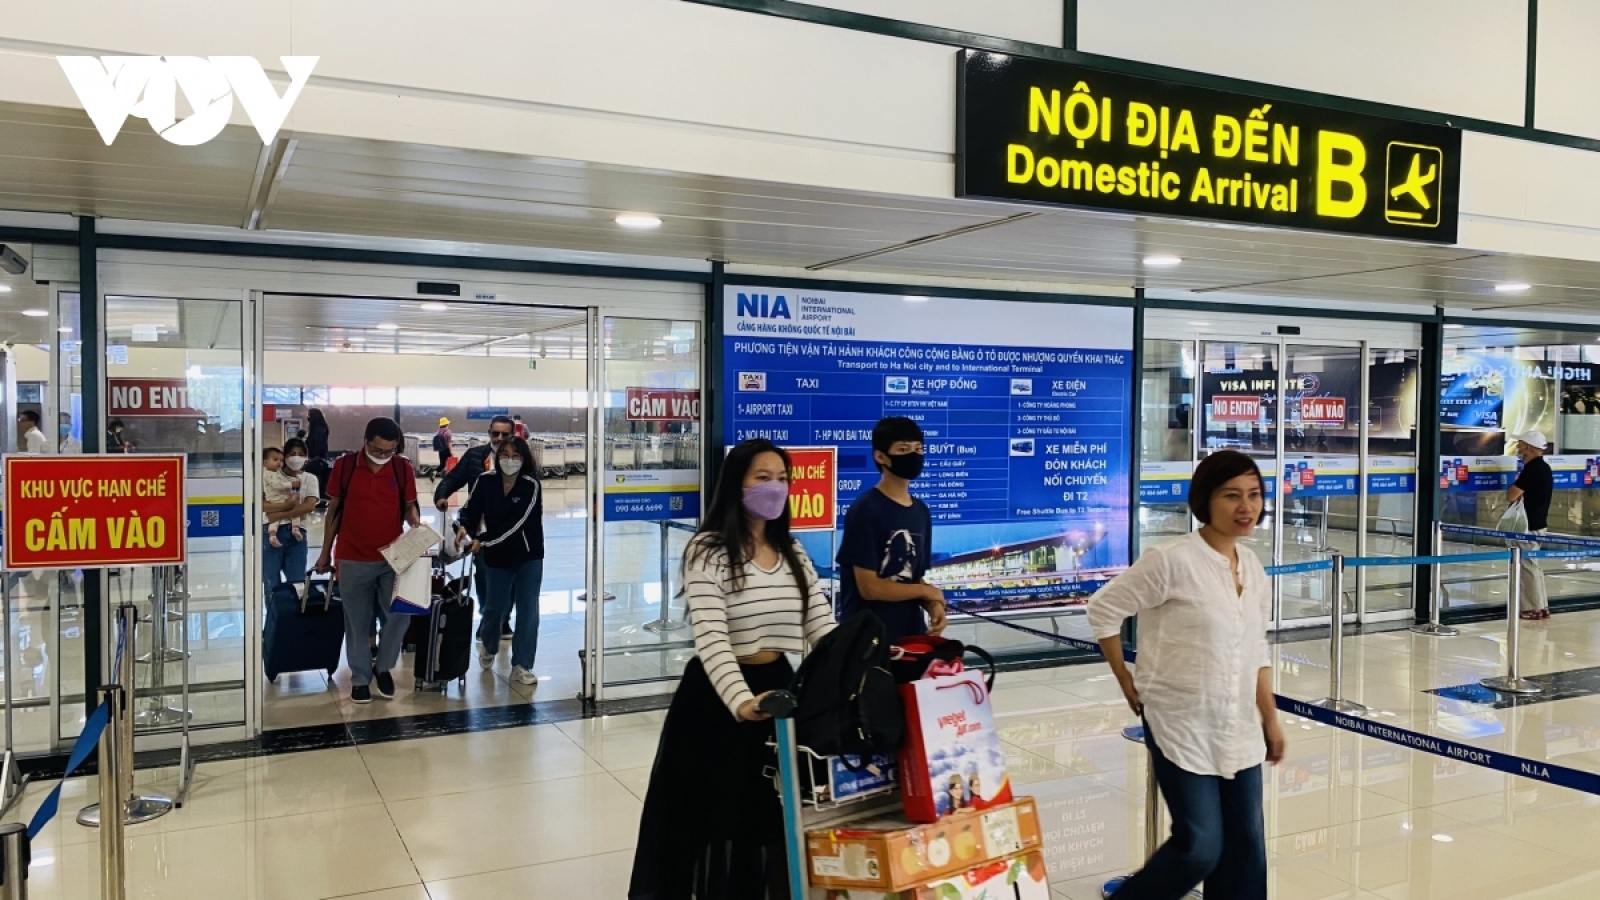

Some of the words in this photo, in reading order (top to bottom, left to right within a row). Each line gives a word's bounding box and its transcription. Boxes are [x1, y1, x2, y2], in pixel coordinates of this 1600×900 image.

[1028, 81, 1111, 148] NỘI
[1127, 102, 1200, 159] ĐỊA
[1213, 104, 1299, 166] ĐẾN
[1007, 143, 1181, 200] Domestic
[1191, 168, 1298, 213] Arrival
[1317, 130, 1367, 219] B
[737, 293, 791, 319] NIA
[801, 297, 826, 305] NOIBAI
[801, 306, 856, 315] INTERNATIONAL
[801, 314, 832, 322] AIRPORT
[737, 320, 756, 332] CẢNG
[757, 322, 777, 333] HÀNG
[778, 323, 801, 334] KHÔNG
[734, 341, 776, 354] PHƯƠNG
[777, 341, 798, 357] TIỆN
[801, 342, 820, 358] VẬN
[822, 342, 837, 356] TẢI
[838, 344, 864, 357] HÀNH
[866, 345, 896, 358] KHÁCH
[898, 346, 923, 359] CÔNG
[925, 347, 950, 362] CỘNG
[951, 346, 975, 360] BẰNG
[998, 350, 1020, 363] ĐƯỢC
[1022, 351, 1056, 364] NHƯỢNG
[1084, 354, 1103, 364] KHAI
[1104, 352, 1124, 365] THÁC
[837, 359, 878, 370] Transport
[880, 361, 889, 369] to
[890, 361, 901, 369] Ha
[903, 361, 917, 370] Noi
[919, 362, 933, 372] city
[935, 363, 950, 371] and
[952, 363, 960, 371] to
[962, 363, 1009, 372] International
[1011, 364, 1043, 373] Terminal
[795, 378, 819, 389] TAXI
[911, 379, 925, 389] XE
[927, 379, 948, 391] HỢP
[949, 376, 978, 390] ĐỒNG
[1051, 380, 1064, 390] XE
[1065, 378, 1086, 392] ĐIỆN
[1220, 380, 1247, 391] VISA
[1251, 378, 1304, 390] INFIITE
[112, 386, 143, 409] NO
[630, 391, 667, 417] CẤM
[671, 395, 700, 417] VÀO
[745, 403, 776, 415] AIRPORT
[777, 404, 793, 415] TAXI
[1214, 400, 1228, 415] NO
[1230, 400, 1258, 416] ENTRY
[1303, 399, 1324, 418] CẤM
[1325, 402, 1344, 418] VÀO
[773, 430, 788, 440] TAXI
[822, 430, 832, 440] HP
[929, 442, 955, 454] BUÝT
[957, 445, 977, 455] (Bus)
[1045, 444, 1059, 454] XE
[1062, 440, 1087, 454] MIỄN
[1090, 442, 1107, 454] PHÍ
[1044, 458, 1068, 470] ĐÓN
[1070, 457, 1107, 470] KHÁCH
[789, 465, 805, 484] ẠN
[807, 459, 826, 479] CHẾ
[1044, 472, 1062, 486] NỐI
[1064, 471, 1107, 485] CHUYẾN
[20, 480, 54, 498] KHU
[59, 477, 93, 503] VỰC
[98, 479, 131, 503] HẠN
[136, 471, 168, 497] CHẾ
[838, 480, 862, 491] GROUP
[789, 488, 825, 518] VÀO
[1063, 491, 1074, 501] ĐI
[1076, 491, 1088, 501] T2
[631, 504, 644, 512] 464
[25, 506, 96, 552] CẤM
[106, 510, 165, 549] VÀO
[1294, 703, 1314, 717] N.I.A
[1335, 715, 1365, 732] NOIBAI
[1367, 724, 1442, 753] INTERNATIONAL
[1446, 746, 1492, 765] AIRPORT
[1521, 762, 1550, 778] N.I.A
